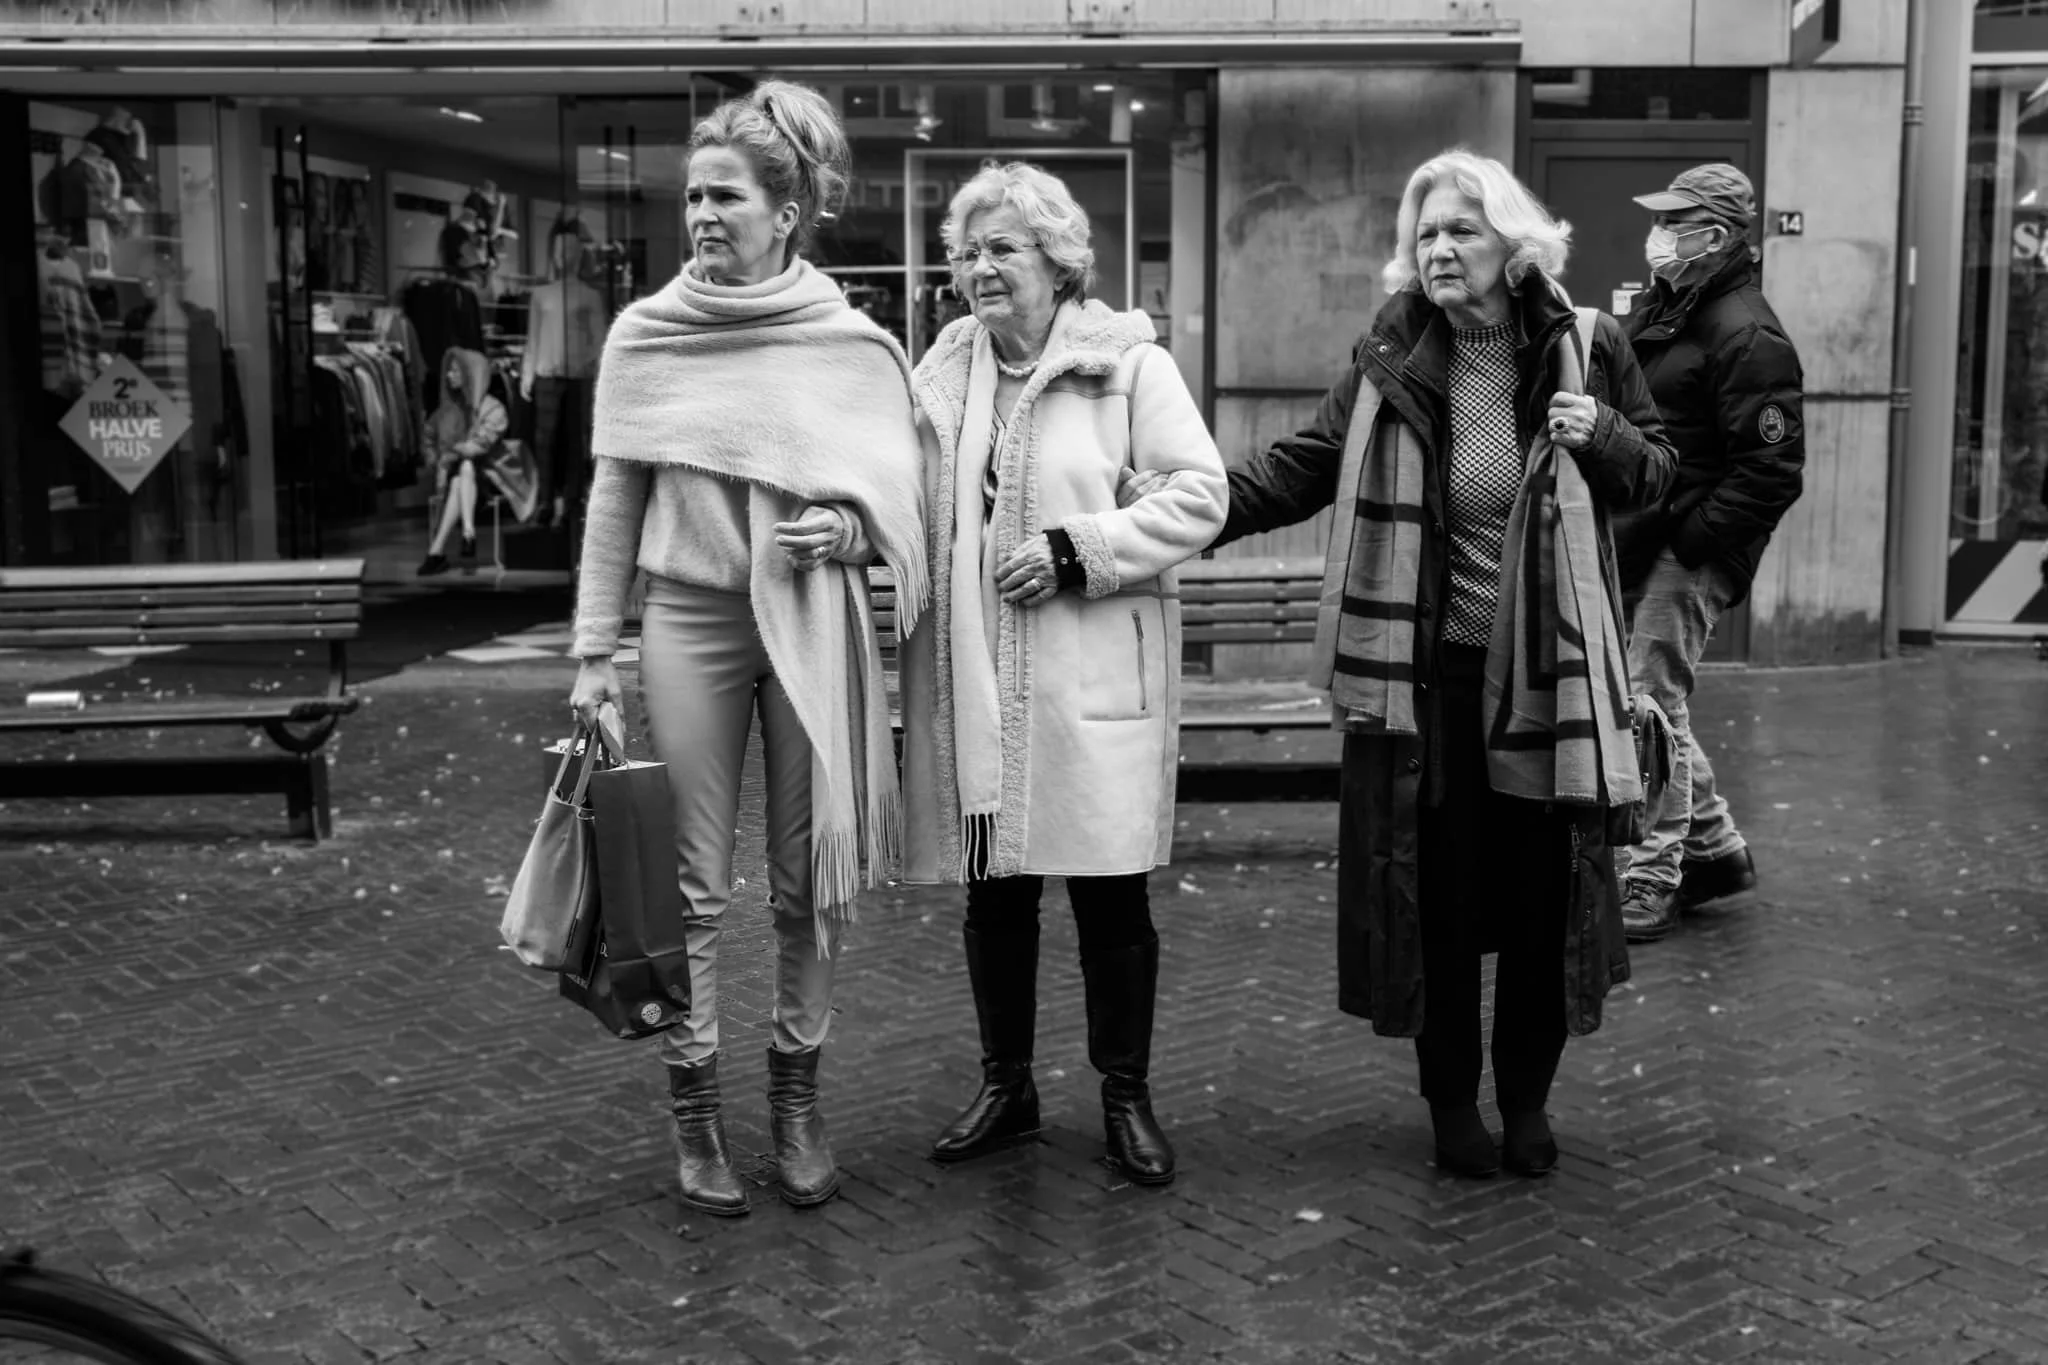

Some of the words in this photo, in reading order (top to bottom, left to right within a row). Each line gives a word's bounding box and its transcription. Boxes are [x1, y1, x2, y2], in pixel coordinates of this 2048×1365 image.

[1780, 214, 1801, 232] 14
[88, 401, 160, 419] BROEK
[89, 418, 163, 440] HALVE
[103, 439, 153, 461] PRIJS
